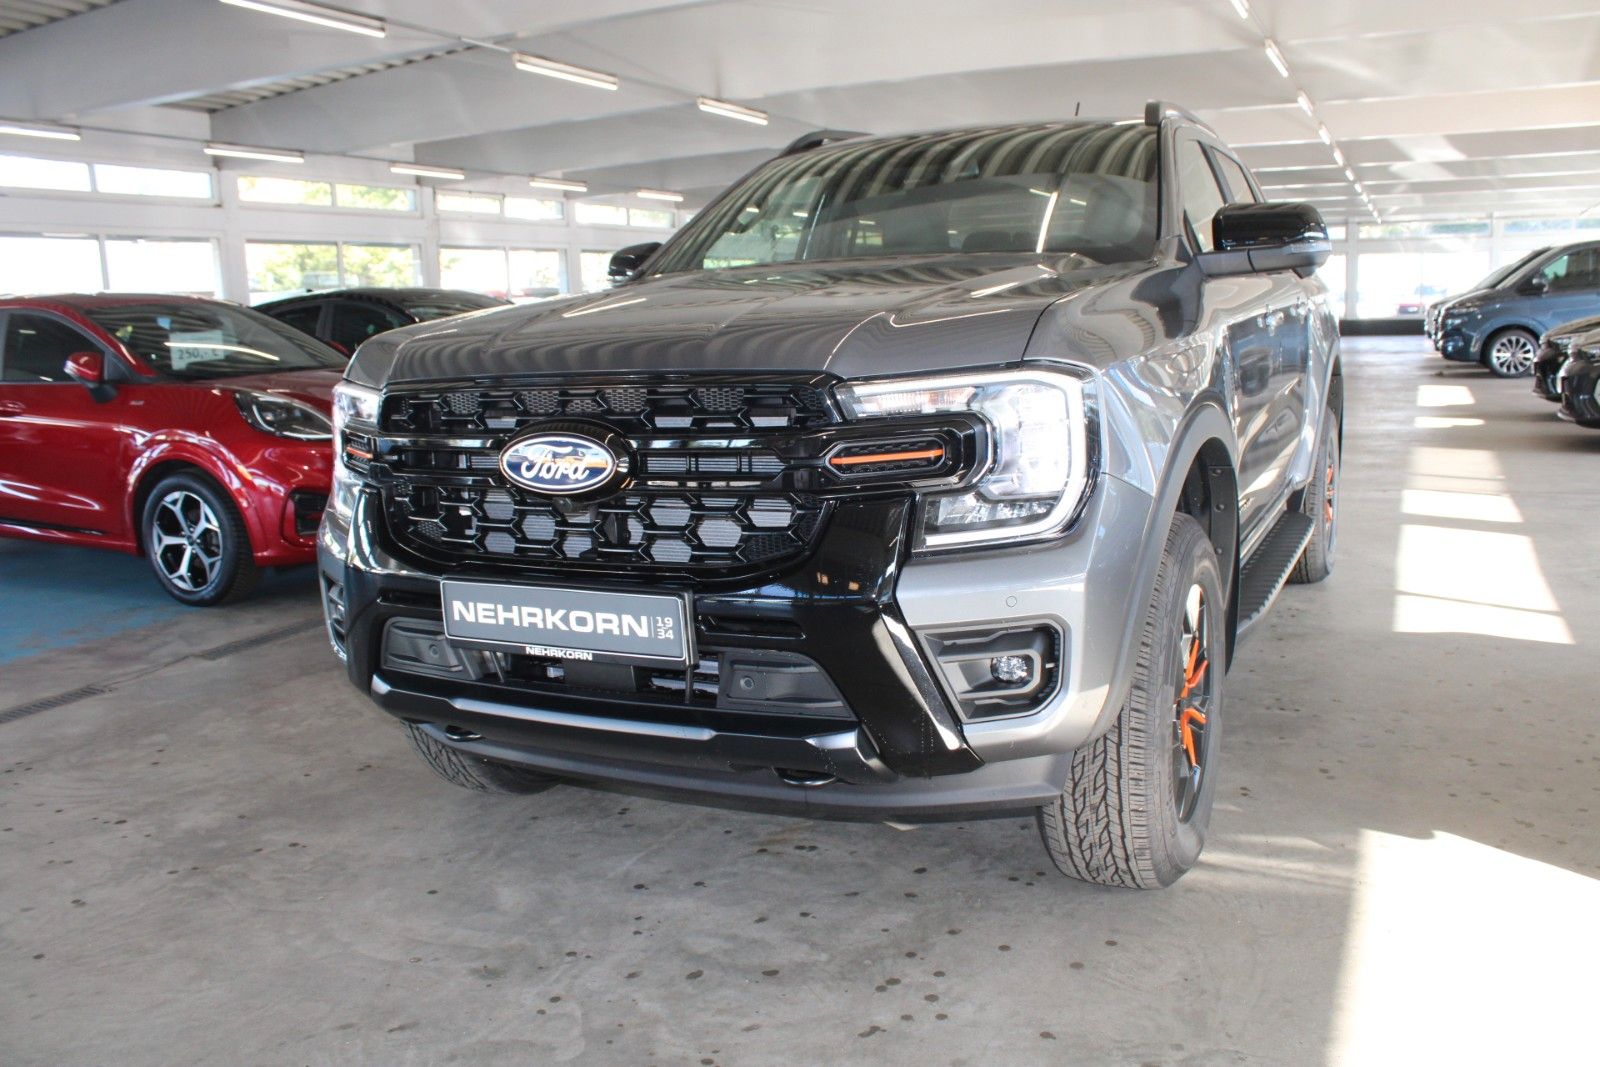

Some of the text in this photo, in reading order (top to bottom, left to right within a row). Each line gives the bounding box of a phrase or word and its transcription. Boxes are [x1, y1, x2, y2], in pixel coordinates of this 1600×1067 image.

[521, 443, 590, 480] Ford
[452, 600, 674, 638] NEHRKORN 19
[657, 628, 675, 640] 34
[525, 646, 593, 661] NEHRKORN
